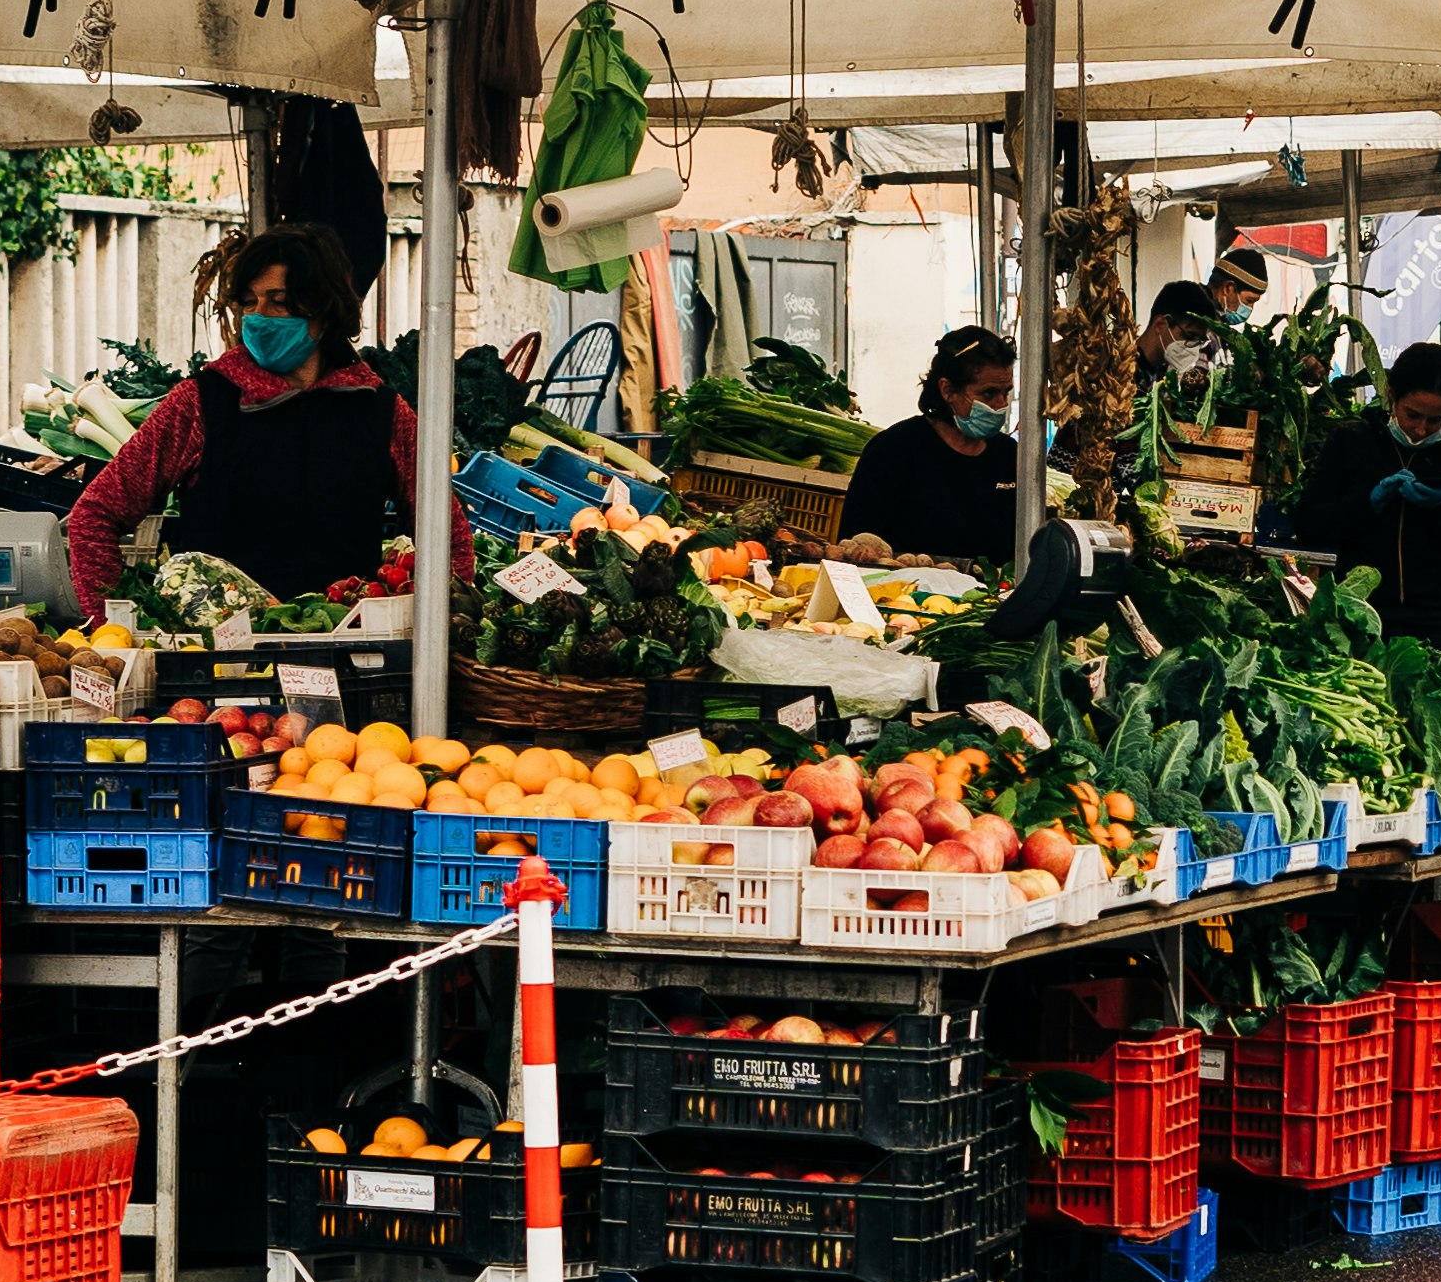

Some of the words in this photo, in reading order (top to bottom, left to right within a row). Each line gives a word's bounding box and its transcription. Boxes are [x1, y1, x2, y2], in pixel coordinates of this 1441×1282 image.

[1170, 500, 1243, 515] MASTER
[714, 1057, 739, 1074] EMO
[743, 1059, 788, 1076] FRUTTA
[708, 1194, 733, 1211] EMO
[737, 1196, 782, 1213] FRUTTA
